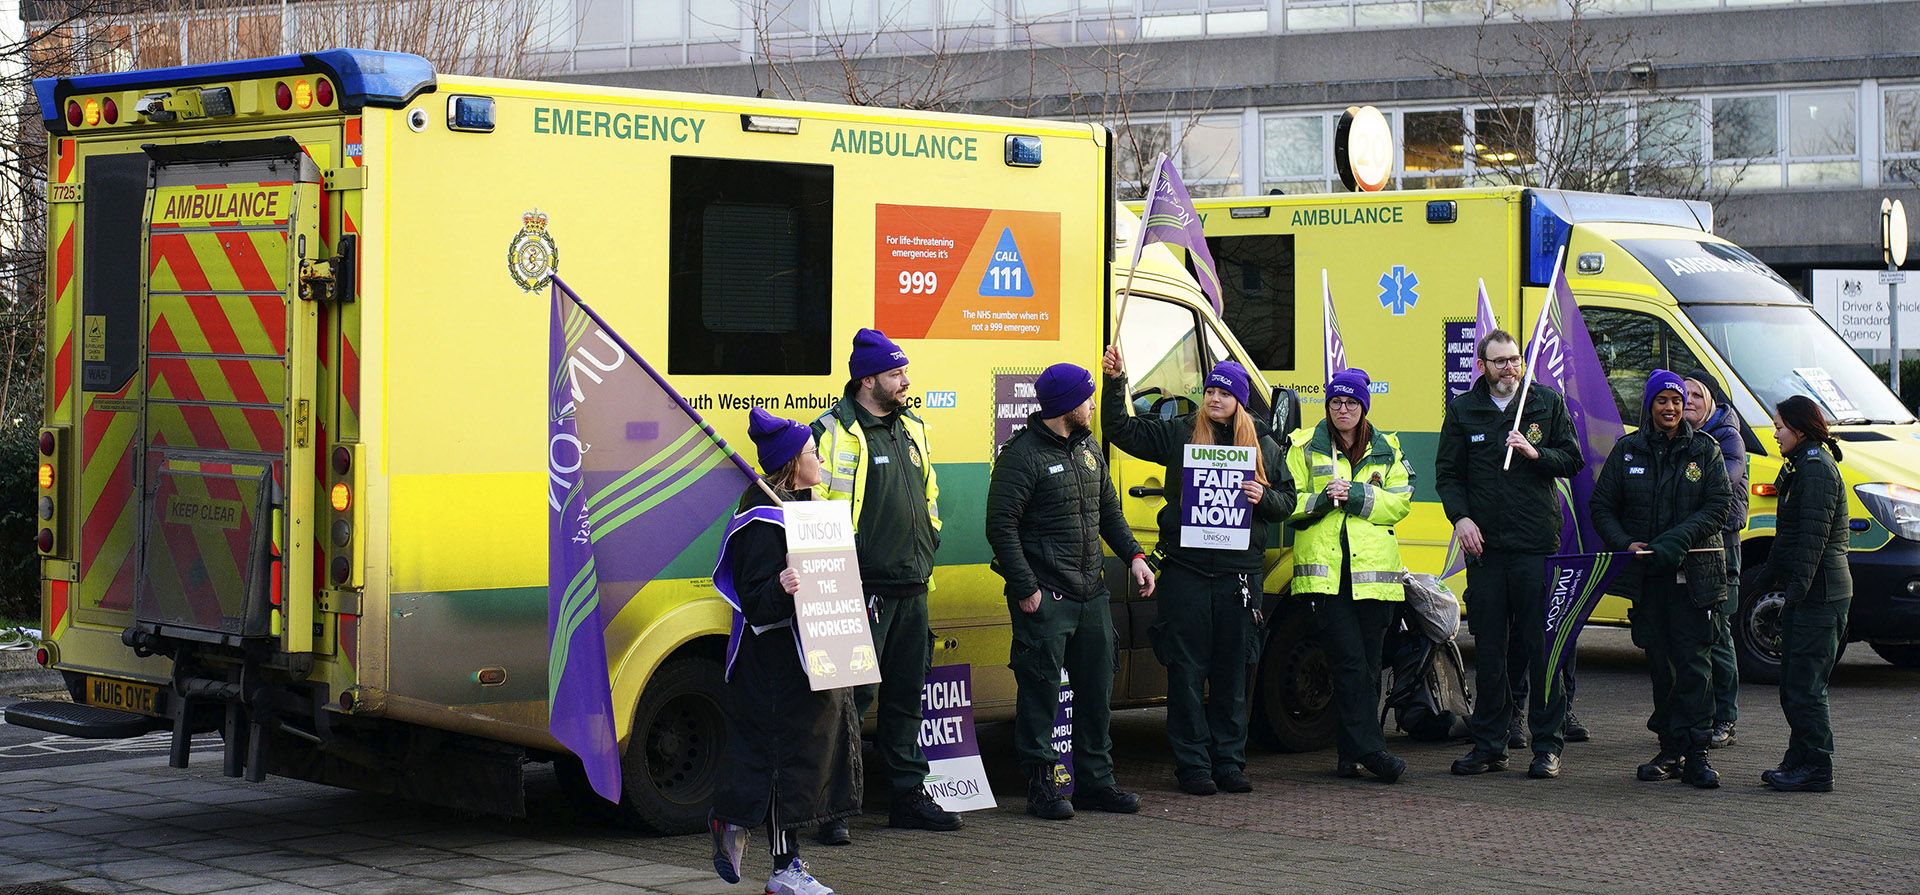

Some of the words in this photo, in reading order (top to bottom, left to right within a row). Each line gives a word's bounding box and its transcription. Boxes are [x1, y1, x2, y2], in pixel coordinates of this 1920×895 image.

[534, 107, 706, 144] EMERGENCY
[831, 128, 978, 162] AMBULANCE
[53, 185, 75, 200] 7725
[164, 191, 279, 219] AMBULANCE
[1291, 206, 1403, 226] AMBULANCE
[886, 235, 899, 244] For
[899, 236, 954, 248] life-threatening
[892, 249, 937, 260] emergencies
[938, 249, 948, 258] it's
[995, 251, 1018, 262] CALL
[899, 271, 937, 295] 999
[990, 266, 1021, 290] 111
[1842, 301, 1872, 312] Driver
[1875, 301, 1883, 312] &
[962, 310, 975, 319] The
[976, 310, 991, 319] NHS
[992, 310, 1018, 320] number
[1019, 312, 1039, 320] when
[1039, 311, 1049, 320] it's
[1842, 315, 1891, 326] Standard
[971, 322, 983, 331] not
[990, 322, 1003, 332] 999
[1004, 324, 1040, 334] emergency
[1842, 329, 1881, 341] Agency
[1447, 342, 1474, 354] AMBULANCE
[1448, 371, 1473, 383] EMERGENC
[1368, 382, 1388, 393] NHS
[718, 394, 780, 410] Western
[784, 393, 839, 410] Ambula
[928, 392, 956, 408] NHS
[997, 403, 1028, 419] AMBULANCE
[1471, 434, 1485, 442] NHS
[875, 456, 889, 464] NHS
[1191, 448, 1248, 462] UNISON
[1049, 464, 1063, 474] NHS
[1193, 469, 1244, 489] FAIR
[1198, 488, 1240, 507] PAY
[172, 502, 200, 518] KEEP
[202, 505, 235, 522] CLEAR
[1191, 506, 1246, 526] NOW
[797, 521, 842, 541] UNISON
[1203, 534, 1231, 542] UNISON
[802, 558, 846, 574] SUPPORT
[817, 580, 838, 594] THE
[801, 599, 862, 617] AMBULANCE
[806, 618, 863, 638] WORKERS
[94, 680, 122, 705] WU16
